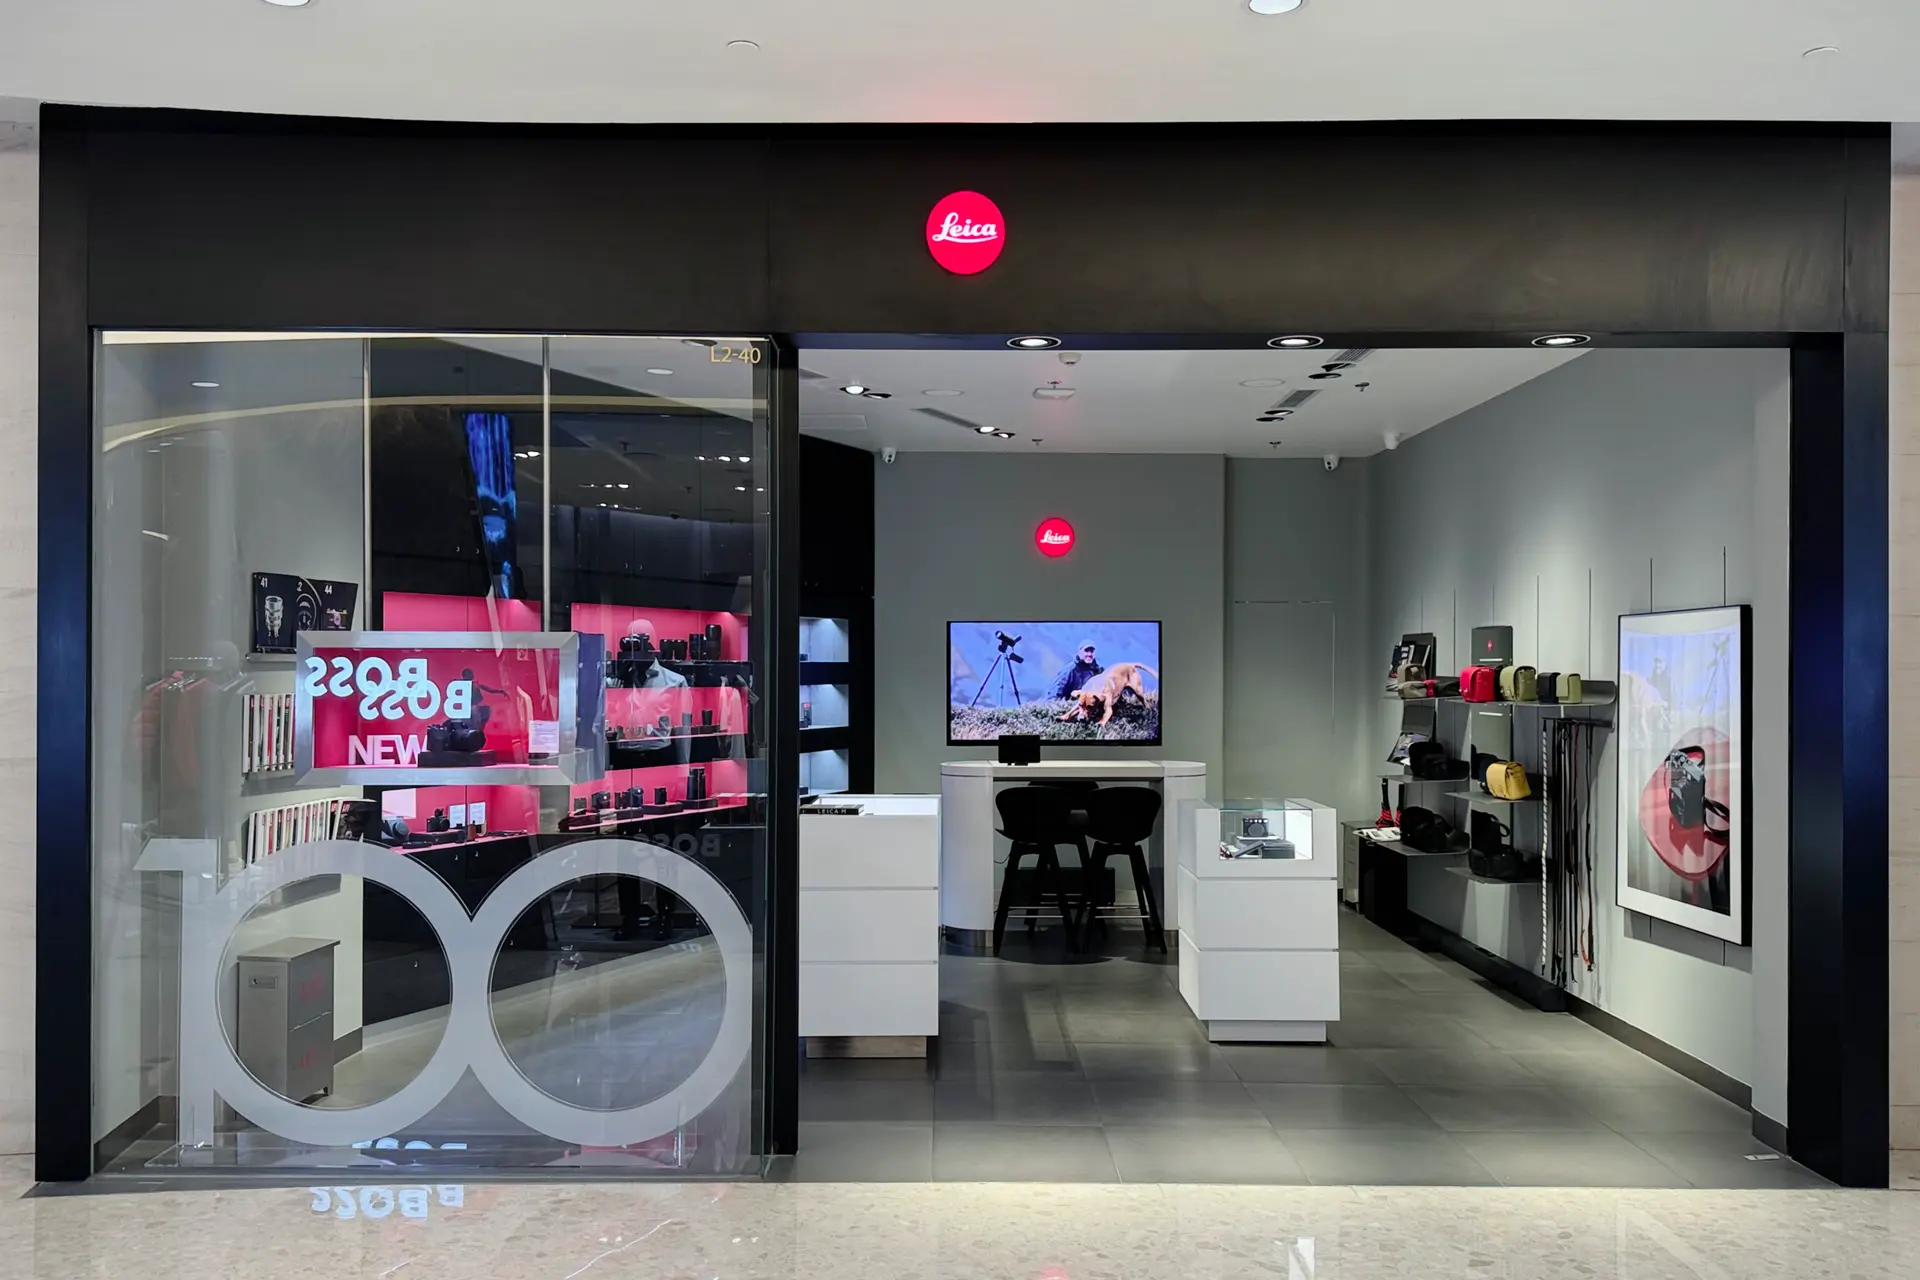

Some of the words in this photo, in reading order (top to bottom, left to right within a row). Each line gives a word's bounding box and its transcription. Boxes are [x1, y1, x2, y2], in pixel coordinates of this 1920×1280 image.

[932, 211, 998, 244] Leica
[710, 346, 761, 364] L2-40
[1040, 529, 1070, 545] Leica
[260, 577, 268, 588] 41
[134, 838, 753, 1147] 100
